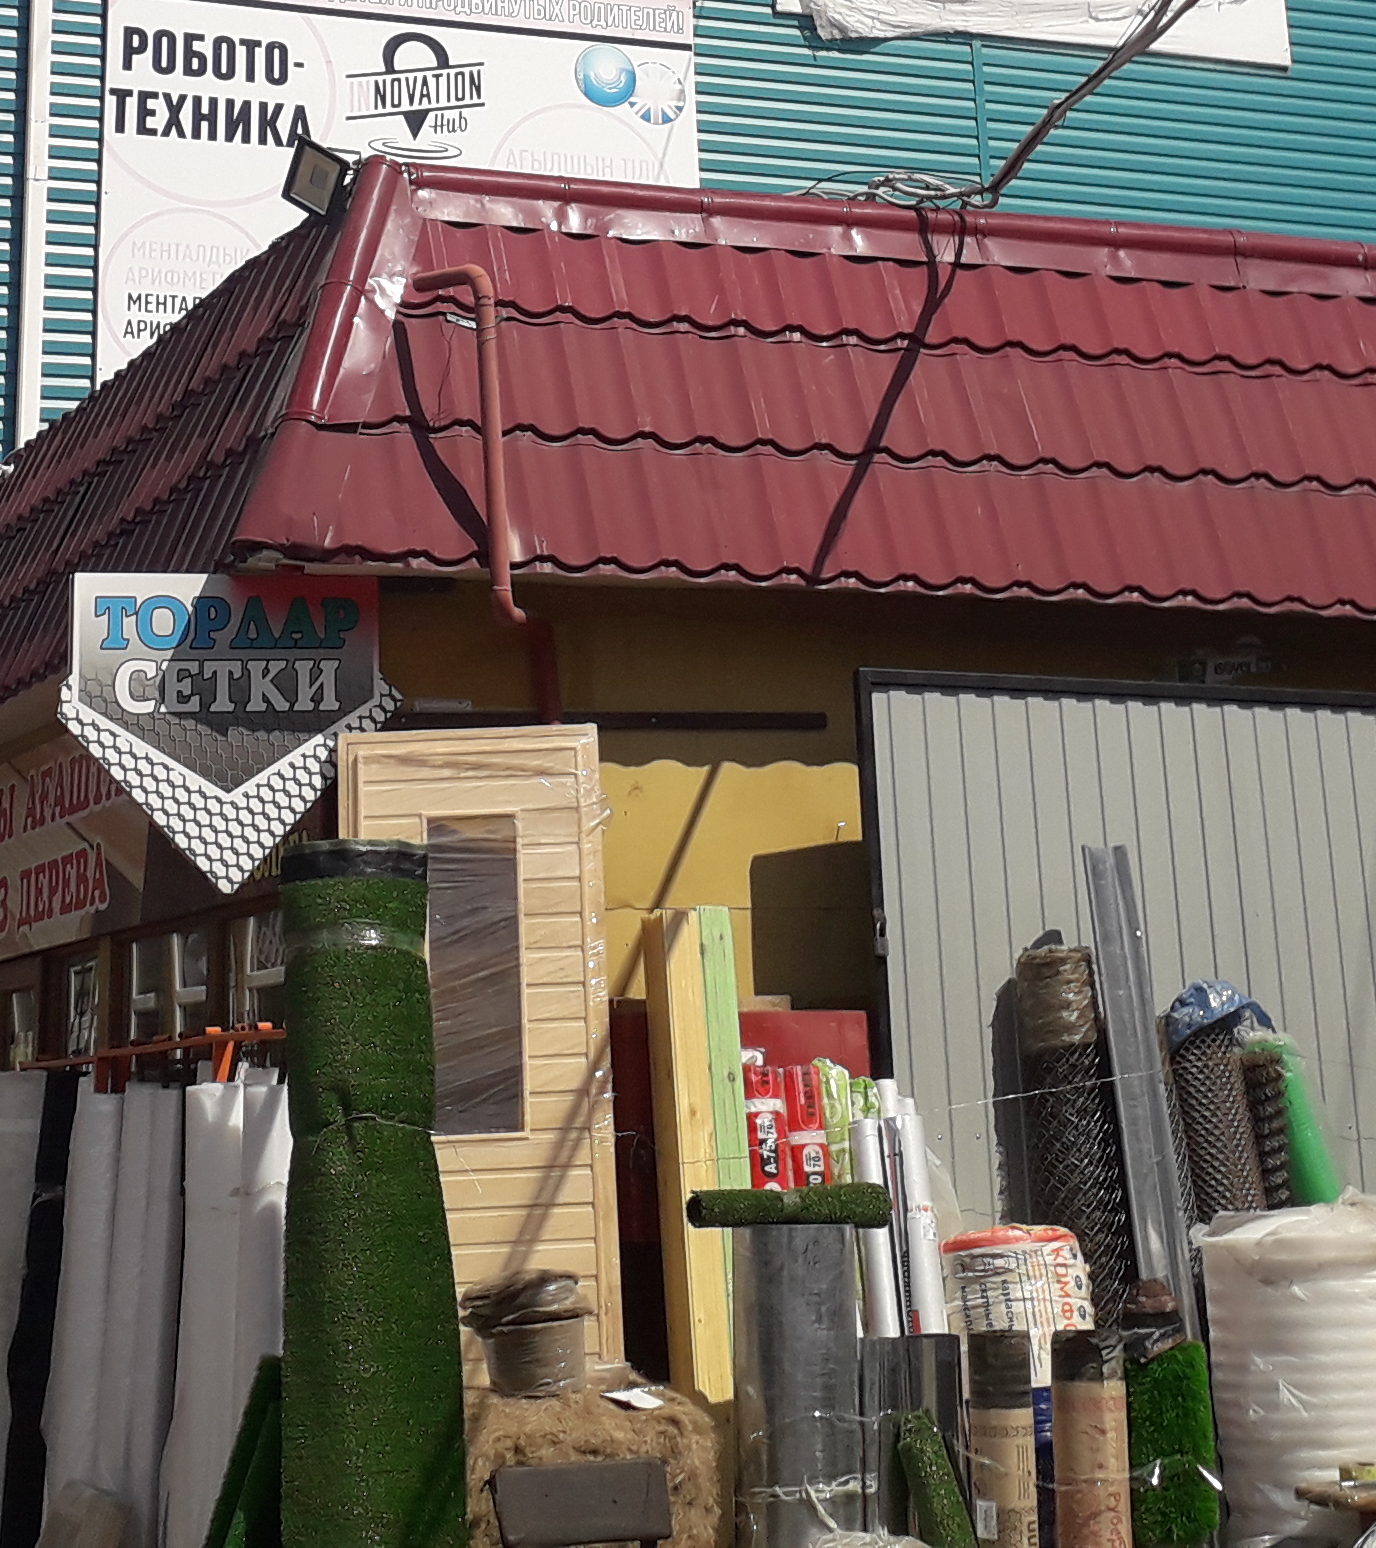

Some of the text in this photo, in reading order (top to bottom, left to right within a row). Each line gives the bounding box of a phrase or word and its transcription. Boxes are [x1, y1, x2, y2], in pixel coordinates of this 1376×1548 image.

[568, 1, 684, 34] РОДИТЕЛЕЙ!
[122, 26, 305, 86] РОБОТО-
[108, 86, 312, 148] ТЕХНИКА
[350, 69, 482, 113] INNOVATION
[428, 110, 468, 134] Hub
[124, 265, 224, 290] АРИФМЕТ
[94, 595, 360, 651] ТОРЛАР
[113, 657, 342, 715] СЕТКИ
[16, 841, 109, 934] ДЕРЕВА
